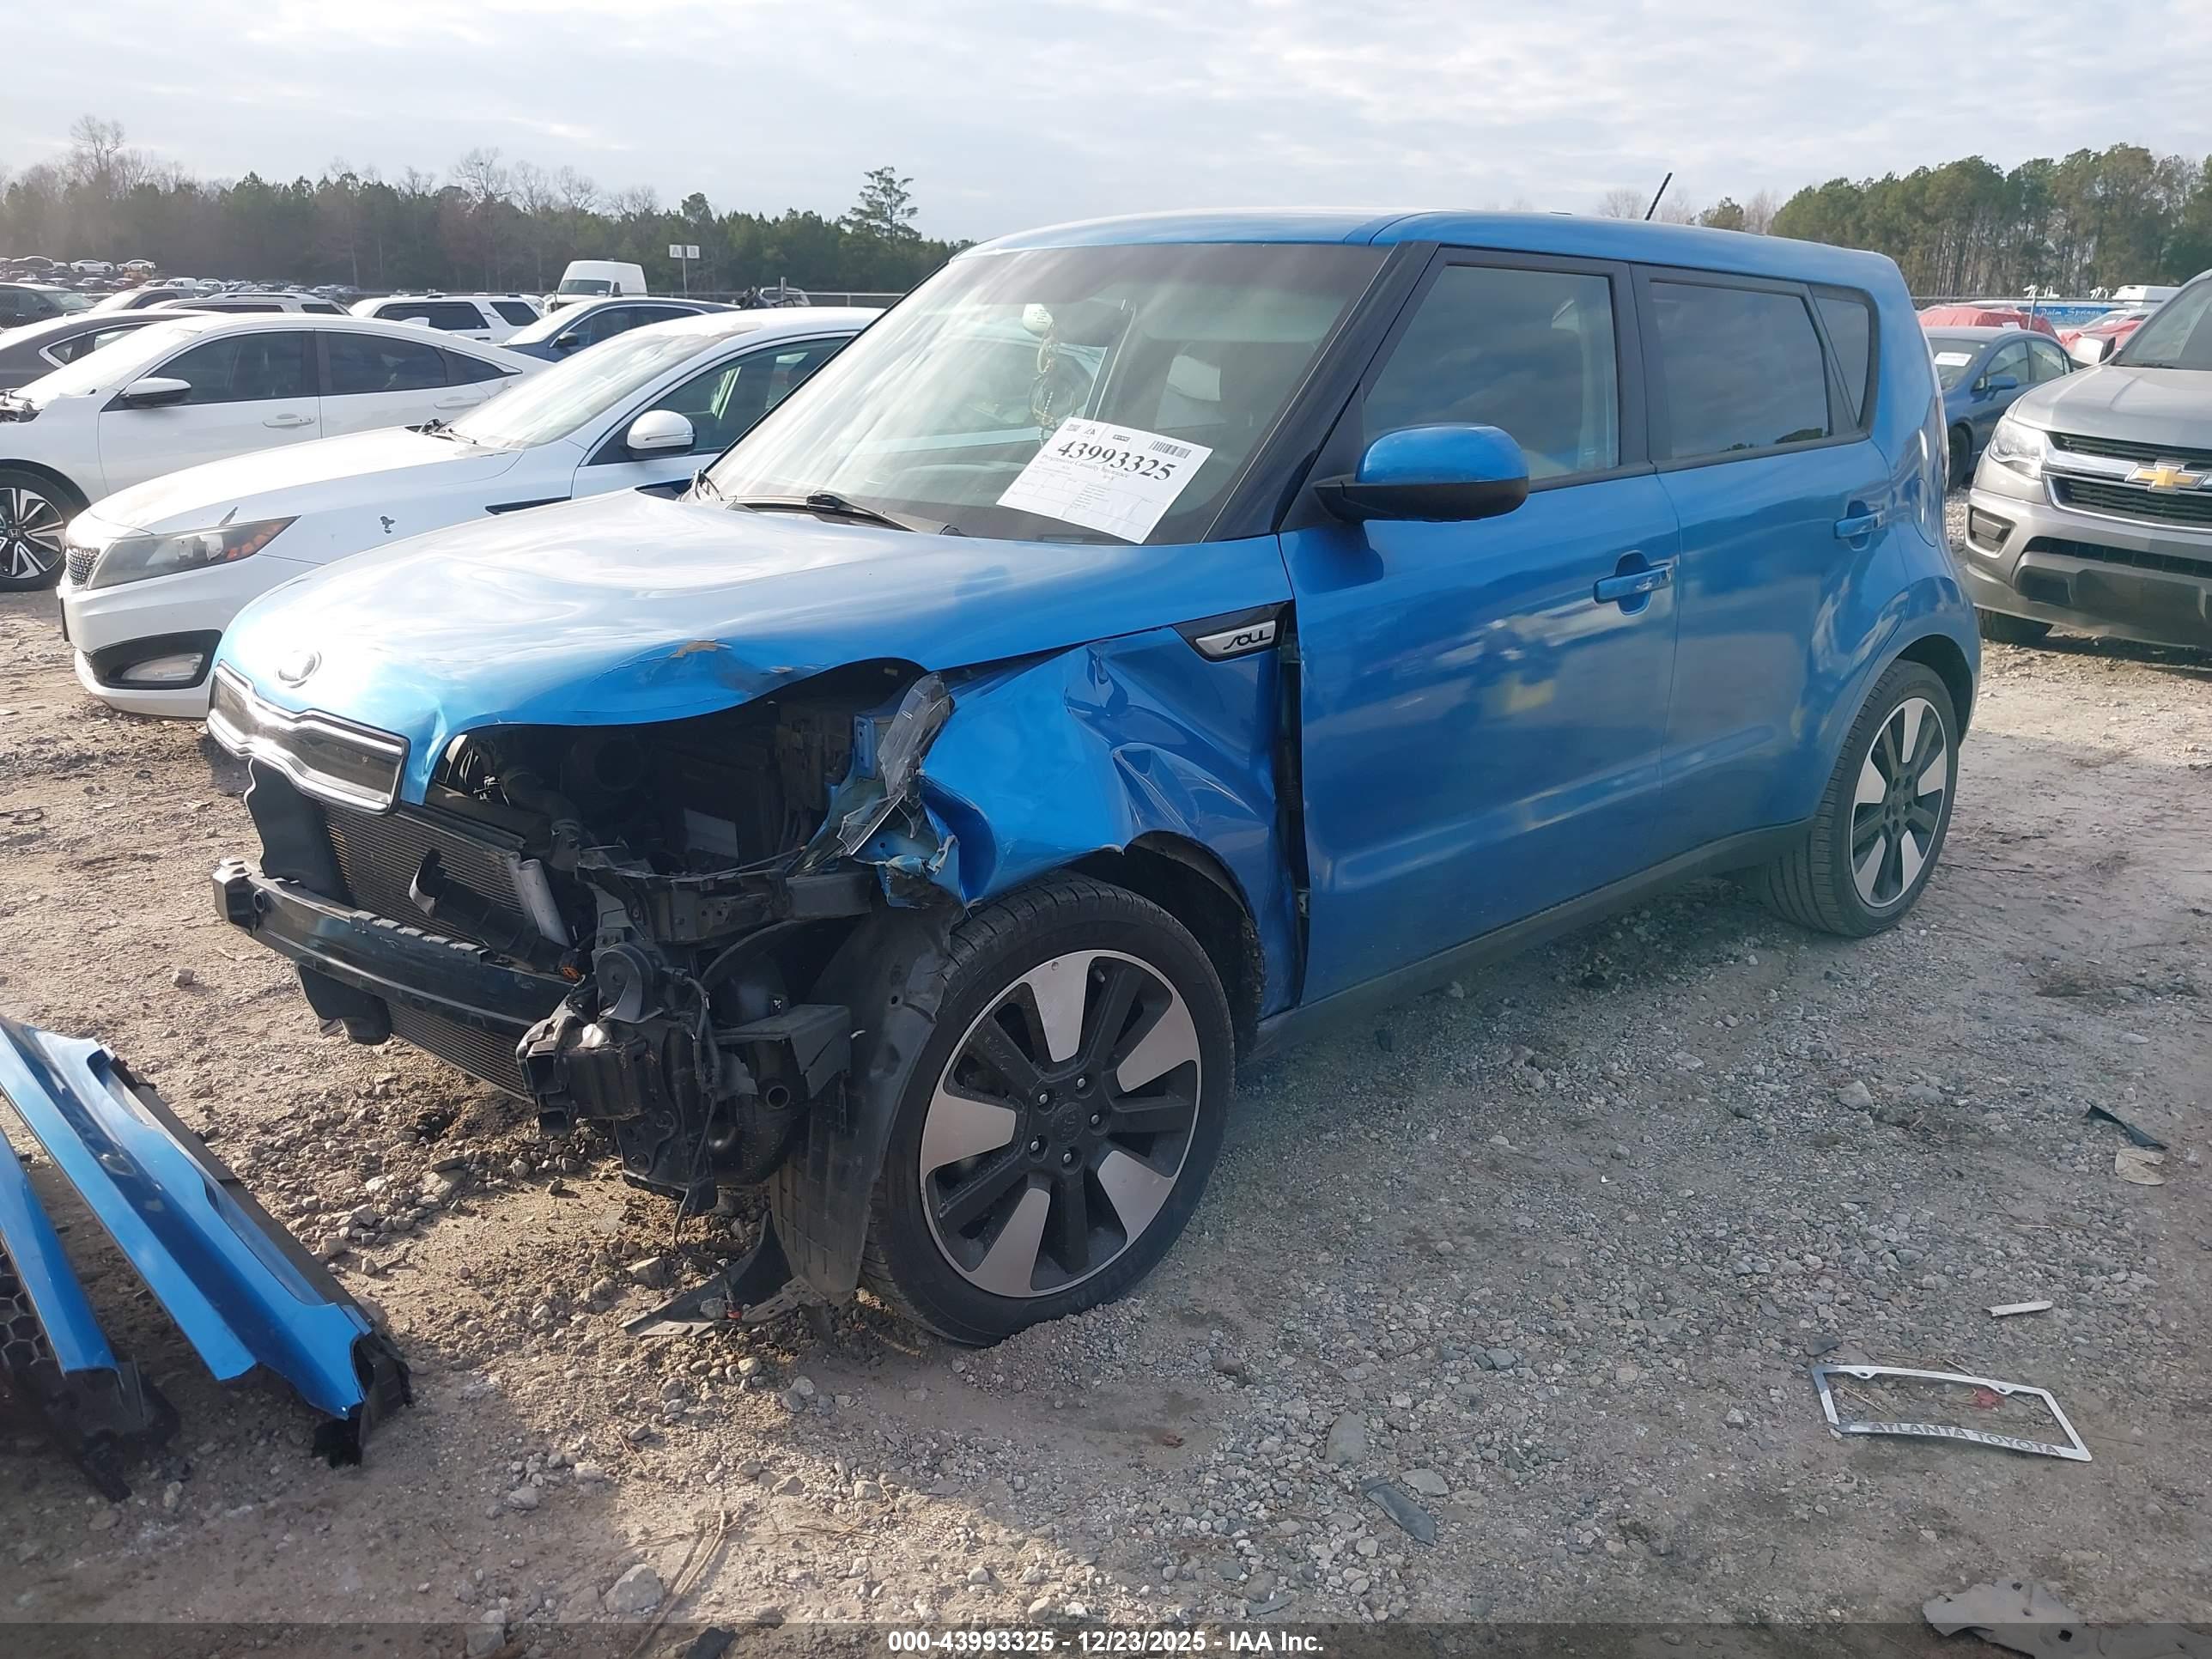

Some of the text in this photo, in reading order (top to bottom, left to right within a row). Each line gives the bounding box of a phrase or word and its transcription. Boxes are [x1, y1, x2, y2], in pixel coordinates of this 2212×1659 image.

[1057, 440, 1177, 482] 43993325
[1869, 1421, 2062, 1455] ATLANTA TOYOTA
